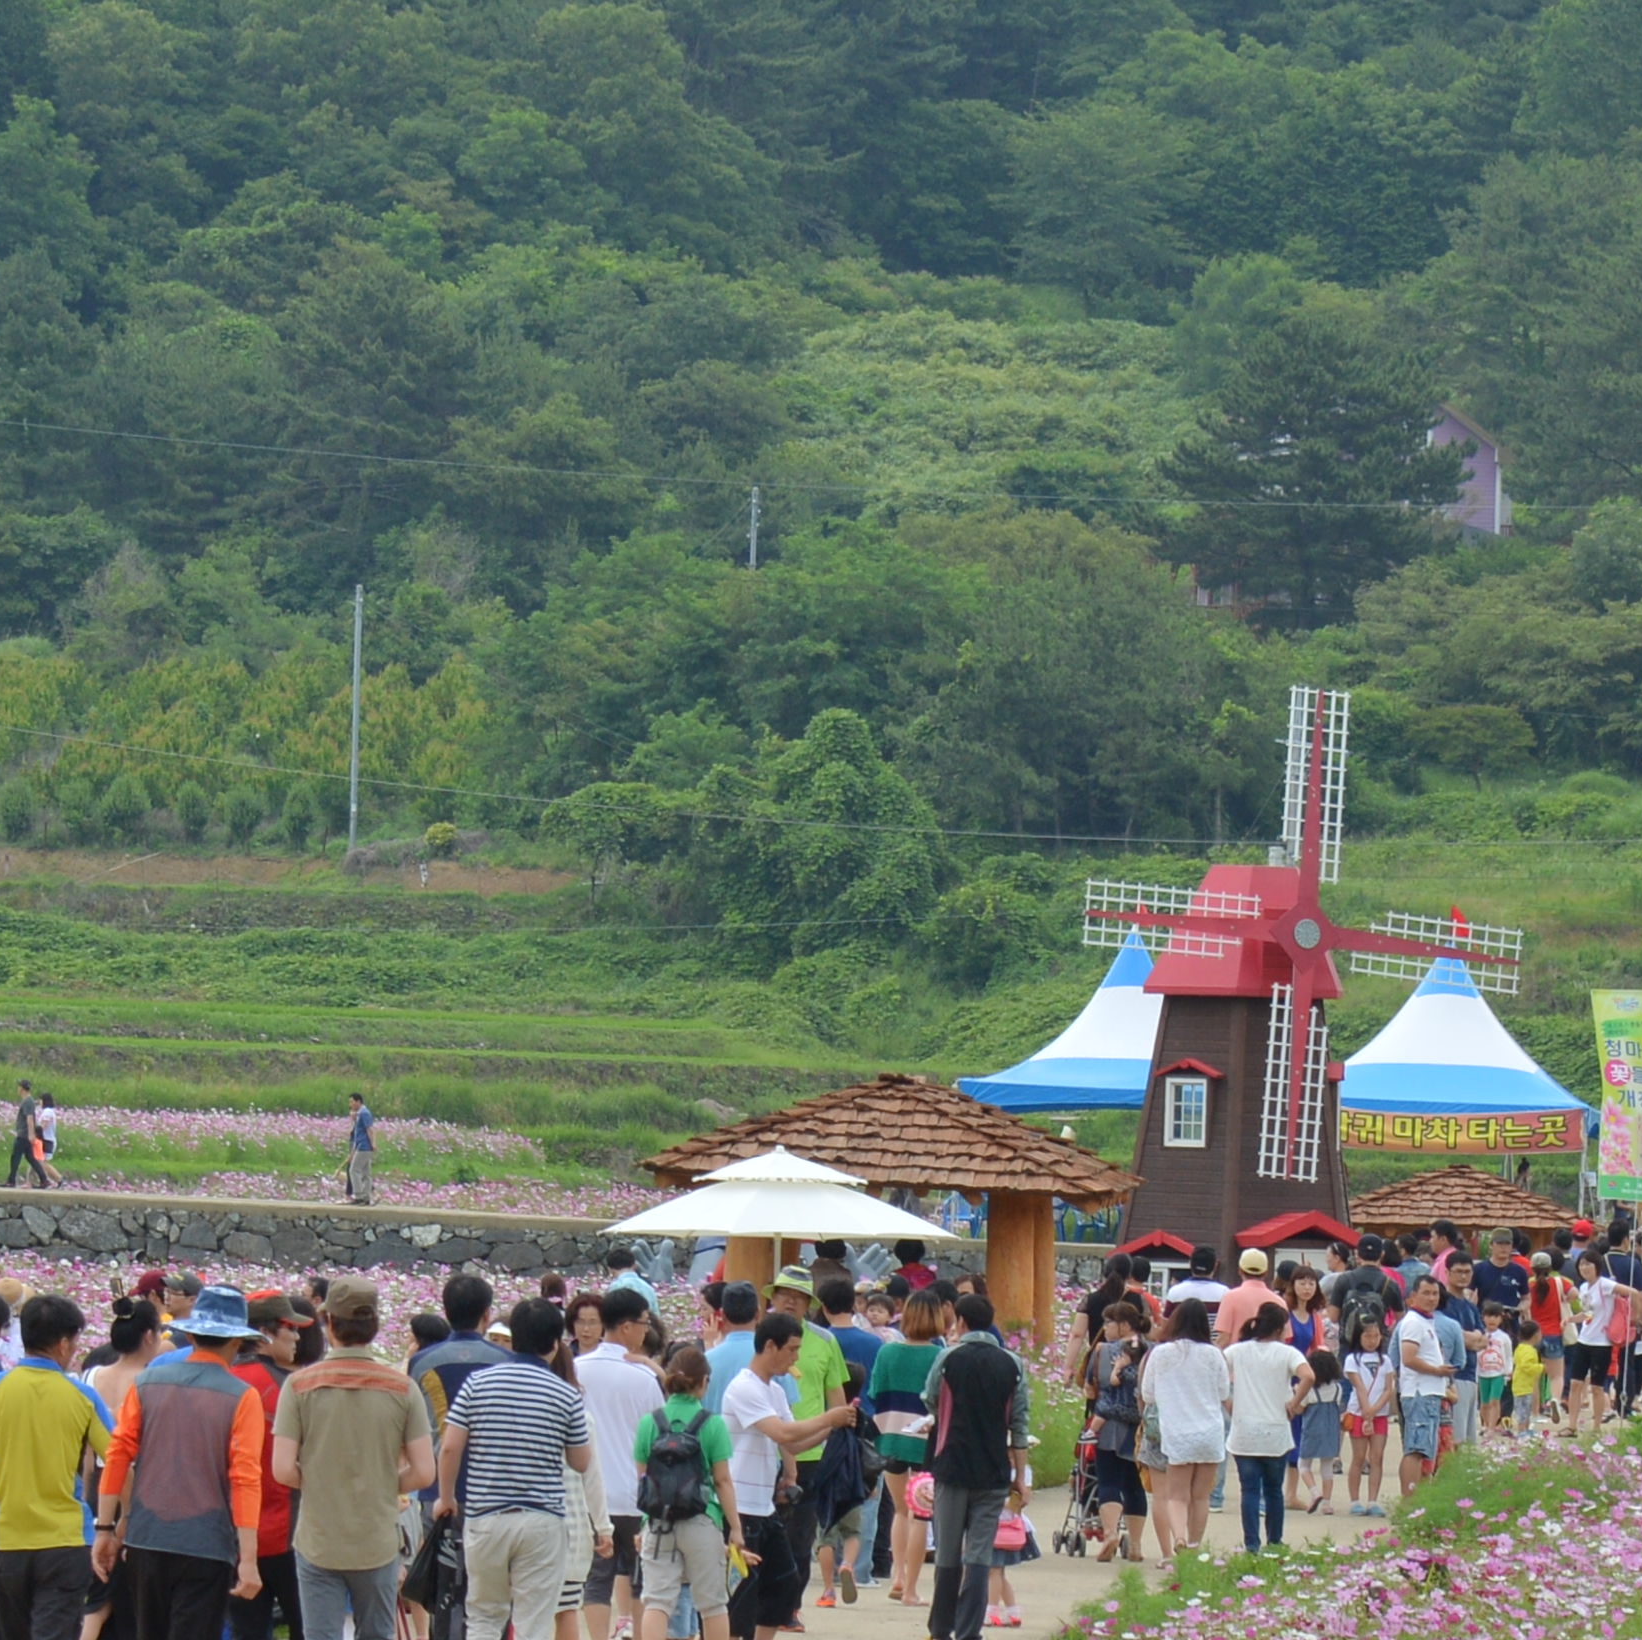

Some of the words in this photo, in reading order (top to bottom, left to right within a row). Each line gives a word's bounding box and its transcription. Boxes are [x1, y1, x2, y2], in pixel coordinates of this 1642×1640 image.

[1604, 1039, 1642, 1059] 청마
[1392, 1115, 1461, 1149] 마차
[1466, 1114, 1568, 1149] 타는곳
